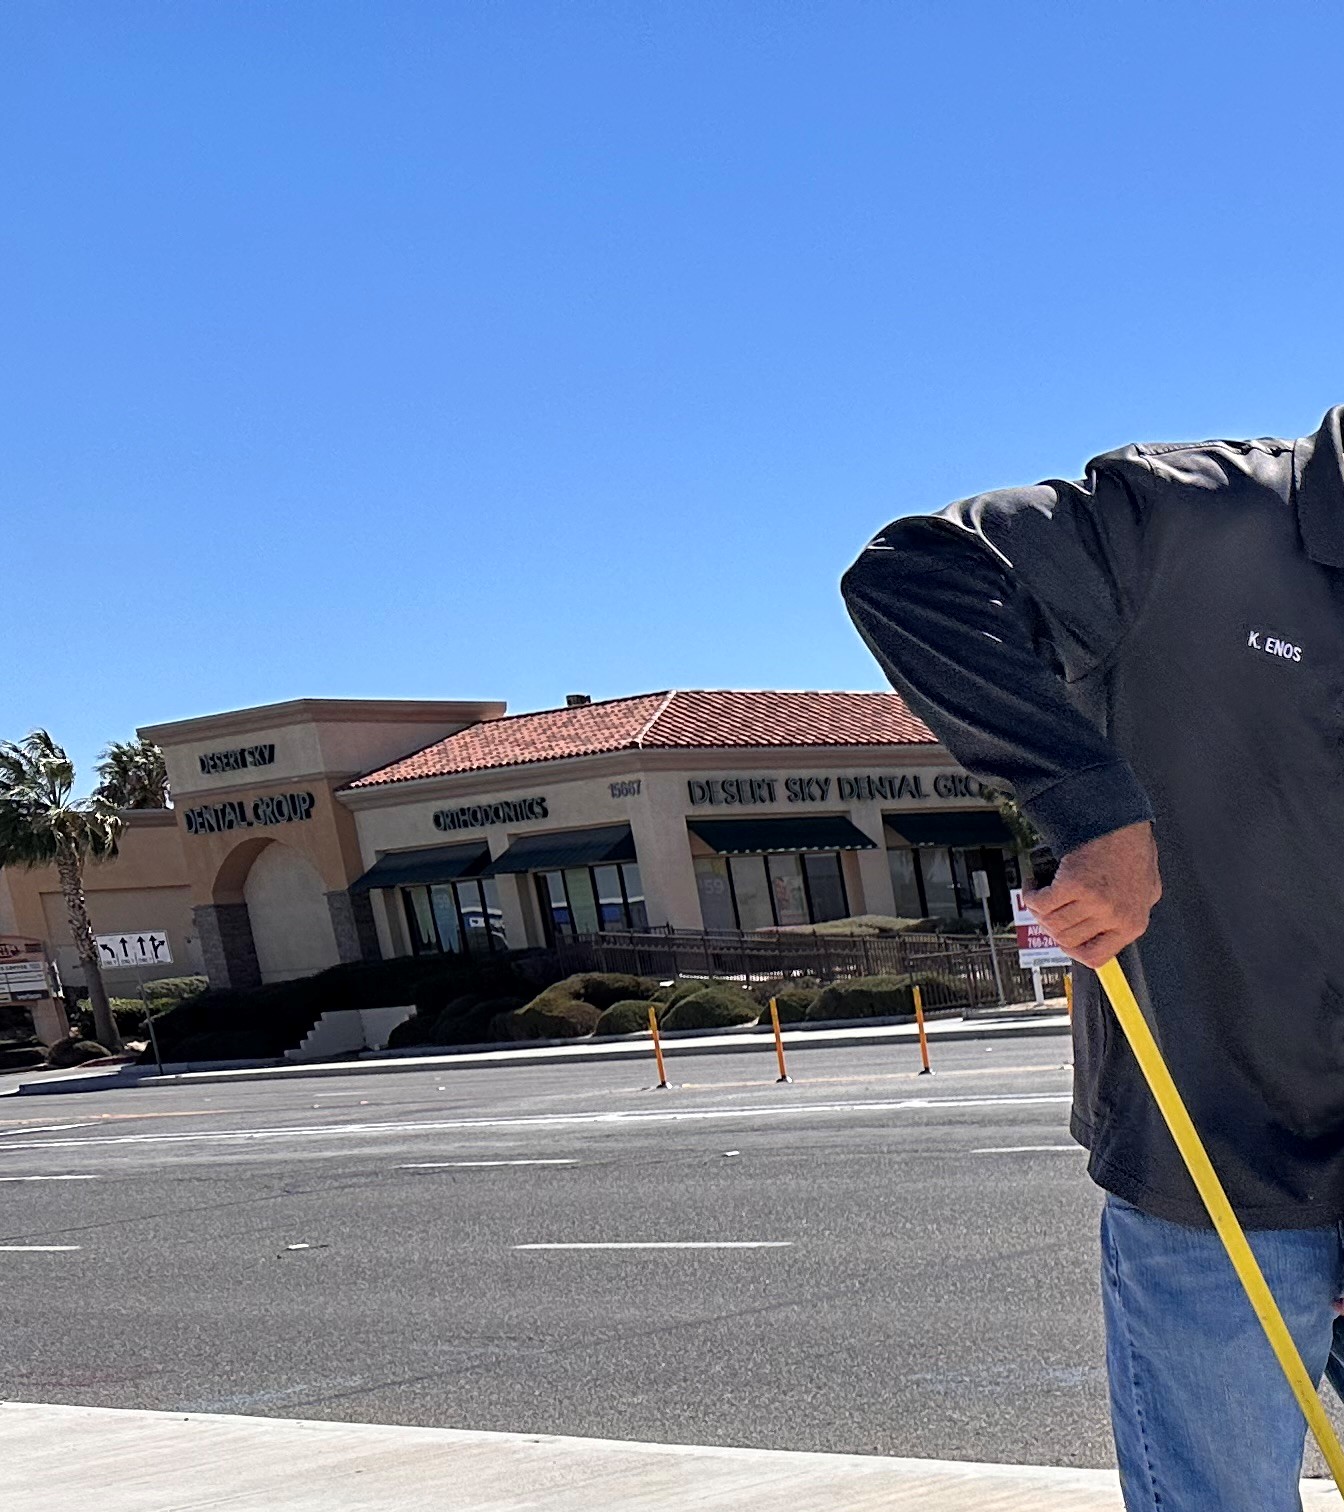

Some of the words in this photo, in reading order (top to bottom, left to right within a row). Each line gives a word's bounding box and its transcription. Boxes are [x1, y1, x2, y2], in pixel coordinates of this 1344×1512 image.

[1247, 630, 1262, 650] K.
[1264, 637, 1303, 662] ENOS
[199, 748, 248, 774] DESERT
[246, 744, 275, 767] SKY
[687, 778, 779, 805] DESERT
[785, 777, 832, 803] SKY
[837, 775, 931, 800] DENTAL
[933, 774, 982, 798] GRO
[184, 801, 249, 835] DENTAL
[252, 792, 315, 826] GROUP
[433, 797, 549, 832] ORTHODONTICS
